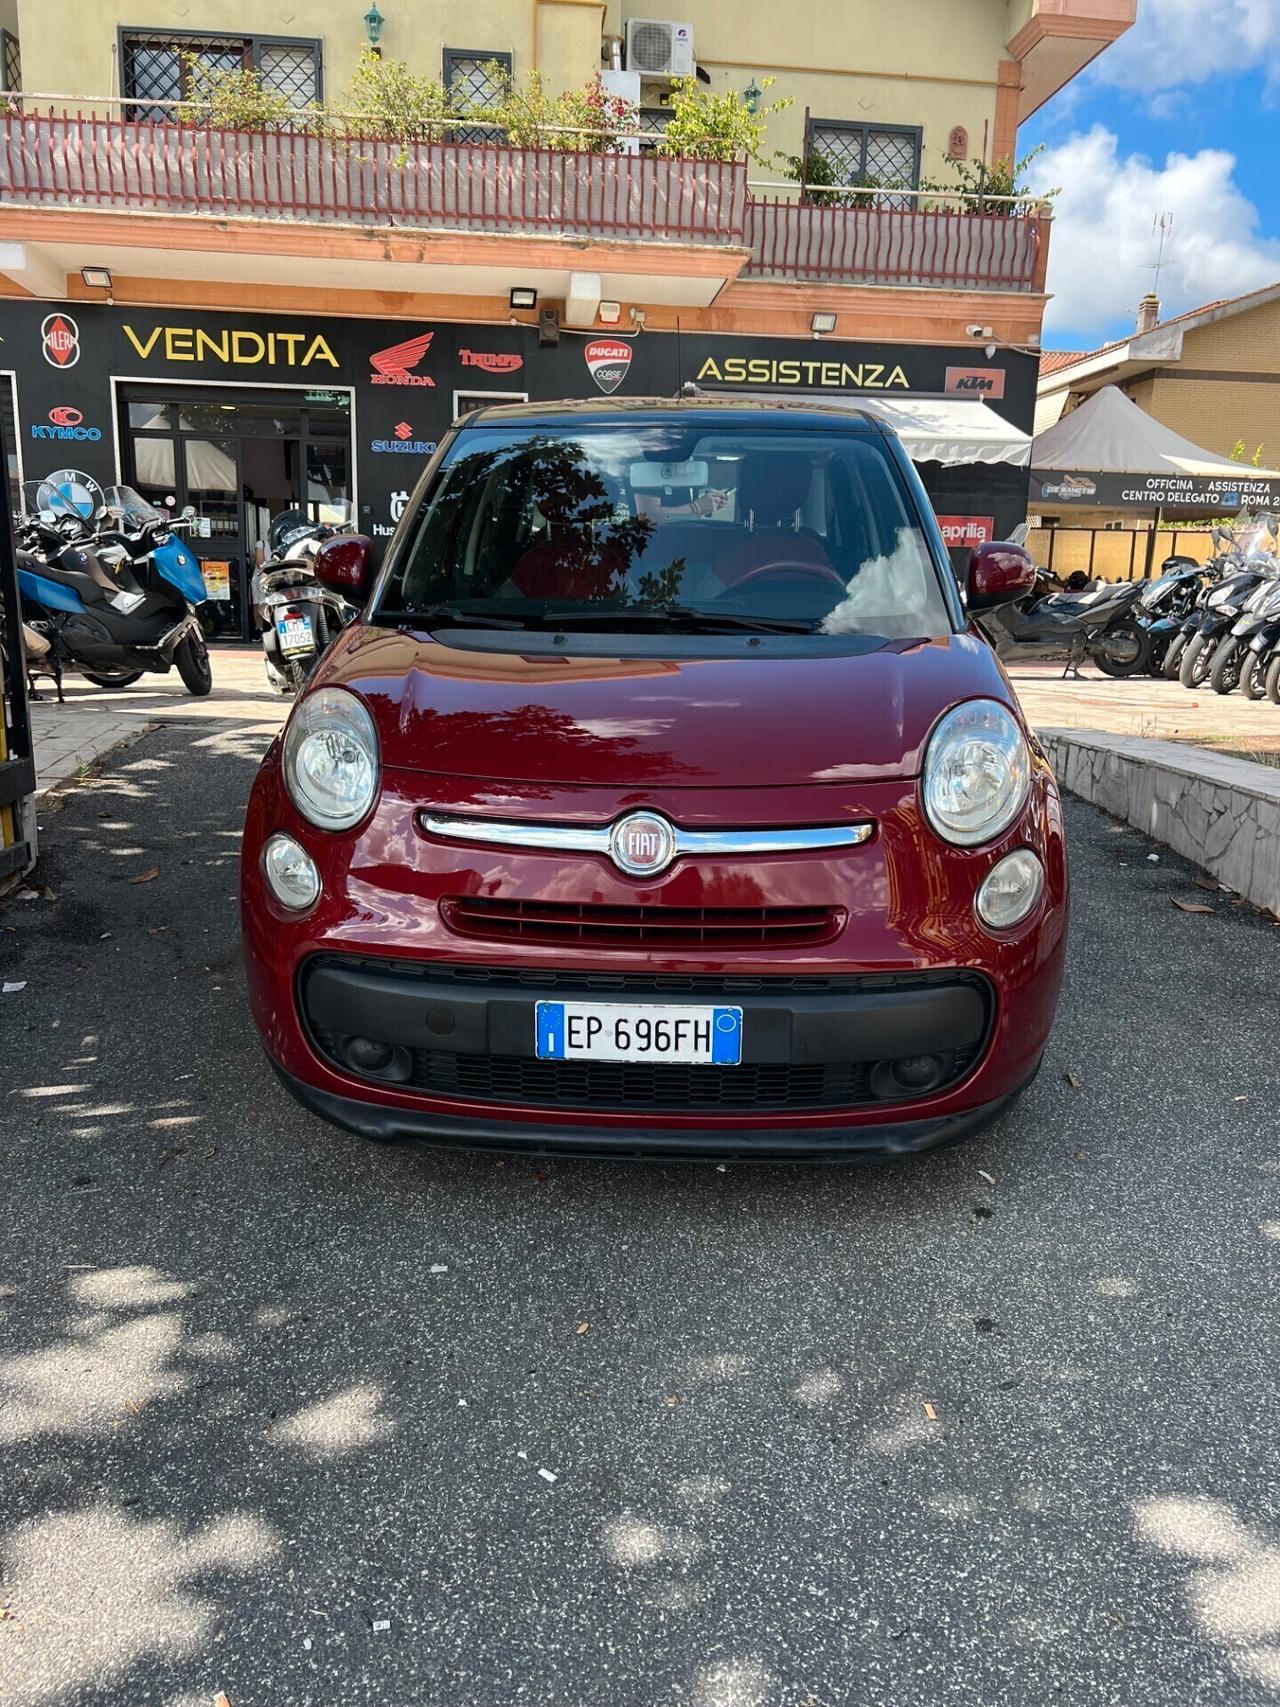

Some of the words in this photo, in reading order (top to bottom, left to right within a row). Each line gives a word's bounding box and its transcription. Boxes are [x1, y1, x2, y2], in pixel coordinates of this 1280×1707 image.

[122, 325, 340, 368] VENDITA
[589, 347, 628, 357] DUCATI
[370, 373, 436, 387] HONDA
[597, 369, 621, 378] CORSE
[697, 357, 910, 388] ASSISTENZA
[956, 376, 993, 390] KTM
[32, 425, 102, 441] KYMCO
[371, 440, 437, 454] SUZUKI
[1146, 478, 1193, 490] OFFICINA
[1208, 481, 1271, 493] ASSISTENZA
[1121, 490, 1165, 502] CENTRO
[1167, 491, 1220, 503] DELEGATO
[1240, 494, 1271, 506] ROMA
[942, 523, 987, 540] aprilia
[628, 832, 658, 856] FIAT
[567, 1015, 602, 1049] EP
[614, 1018, 711, 1053] 696FH
